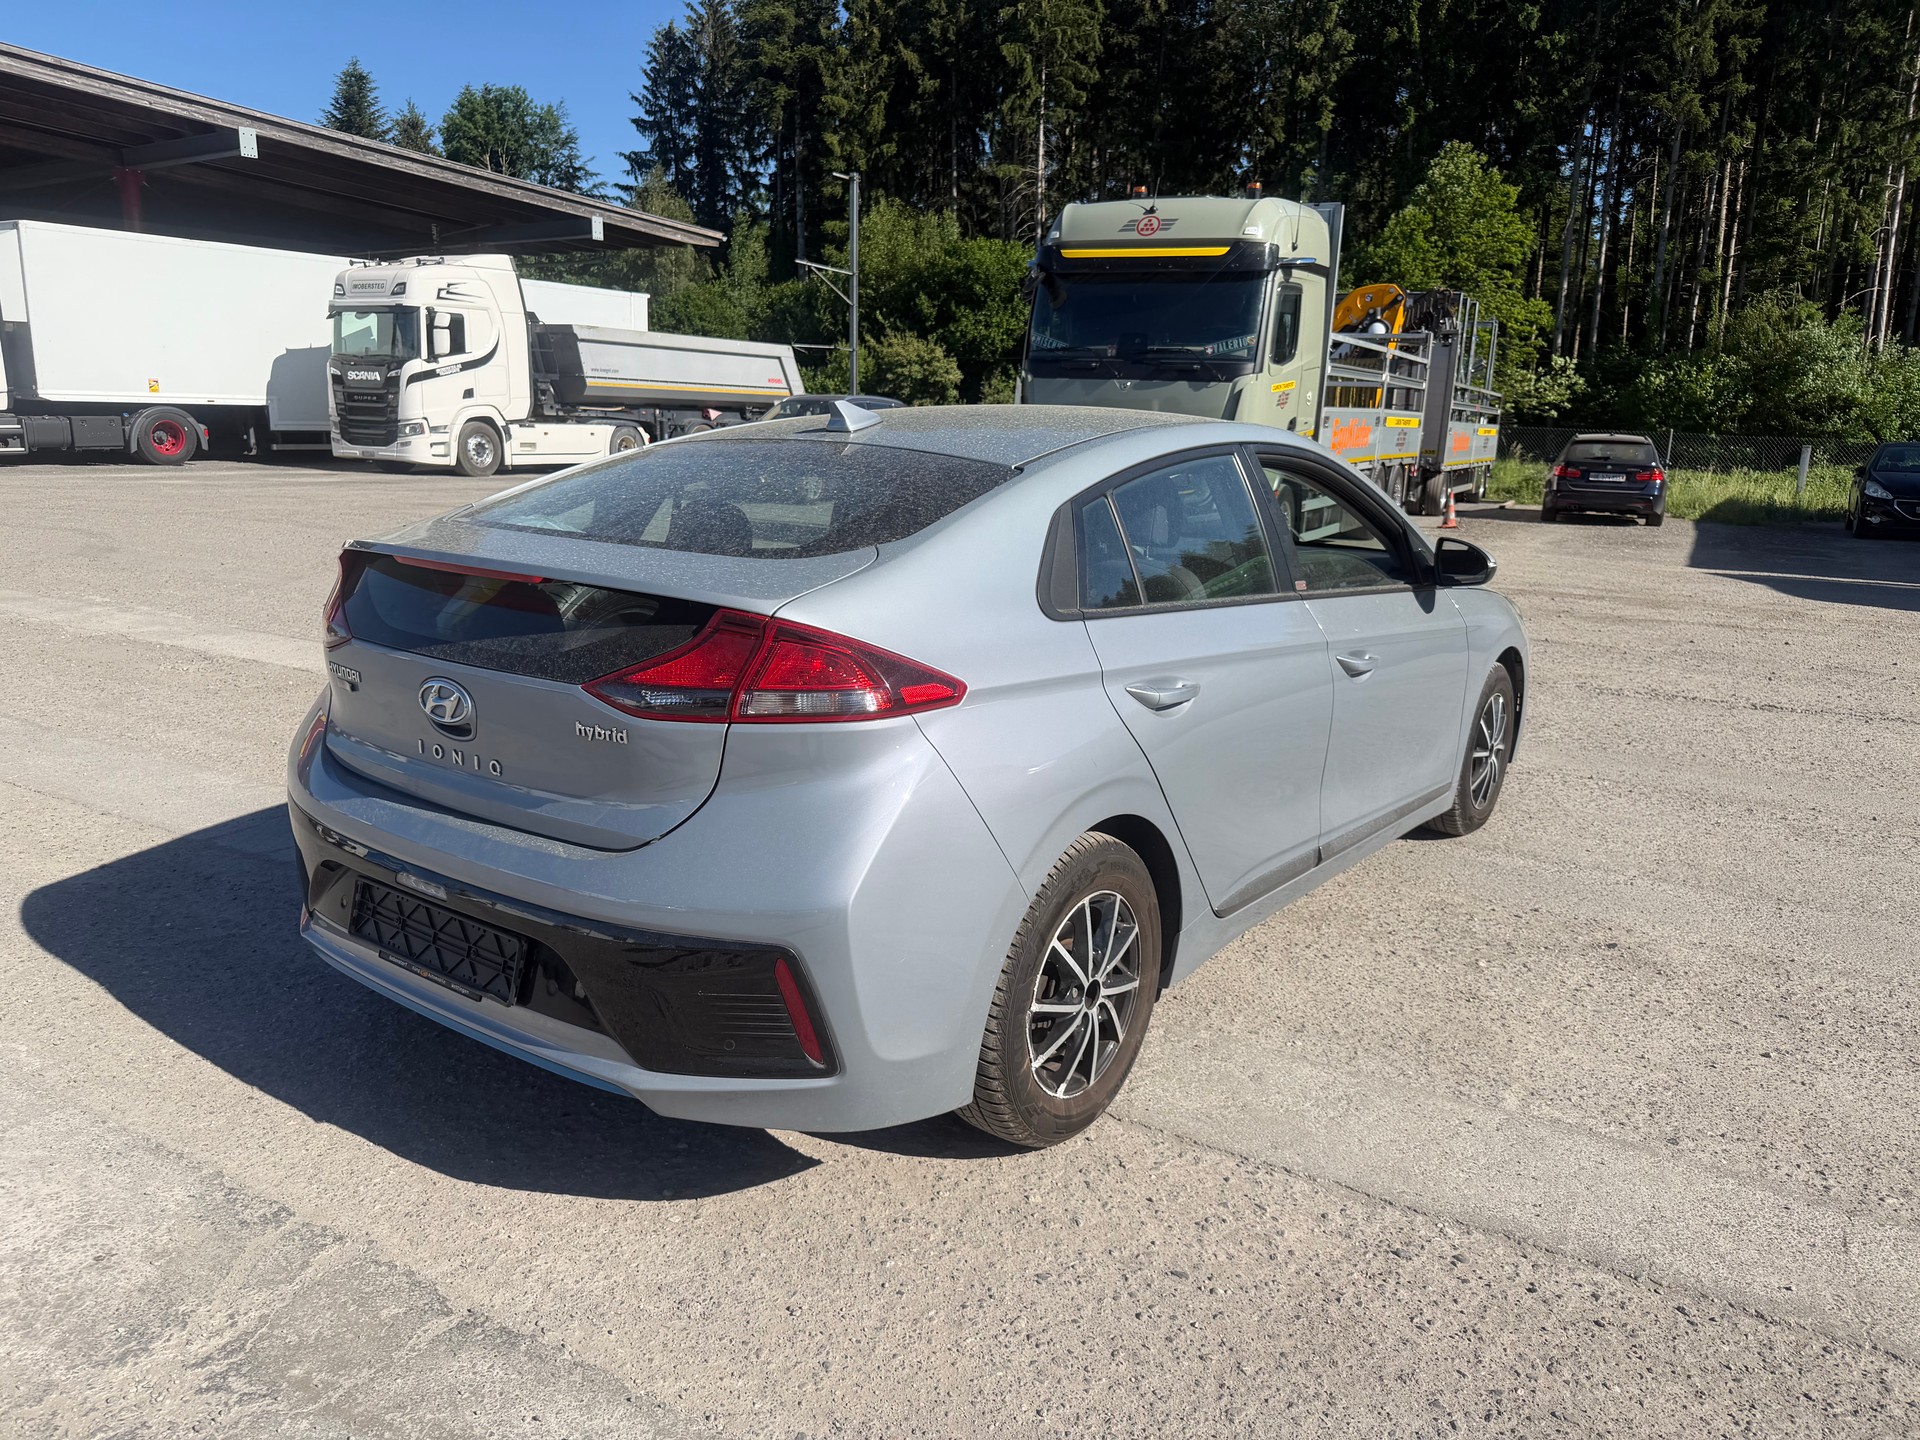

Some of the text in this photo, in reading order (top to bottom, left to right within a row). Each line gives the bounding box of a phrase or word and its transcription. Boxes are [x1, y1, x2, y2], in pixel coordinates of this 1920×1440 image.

[347, 371, 381, 380] SCANIA
[328, 661, 361, 682] HYUNDAI
[575, 720, 628, 744] hybrid
[418, 738, 502, 776] IONIQ
